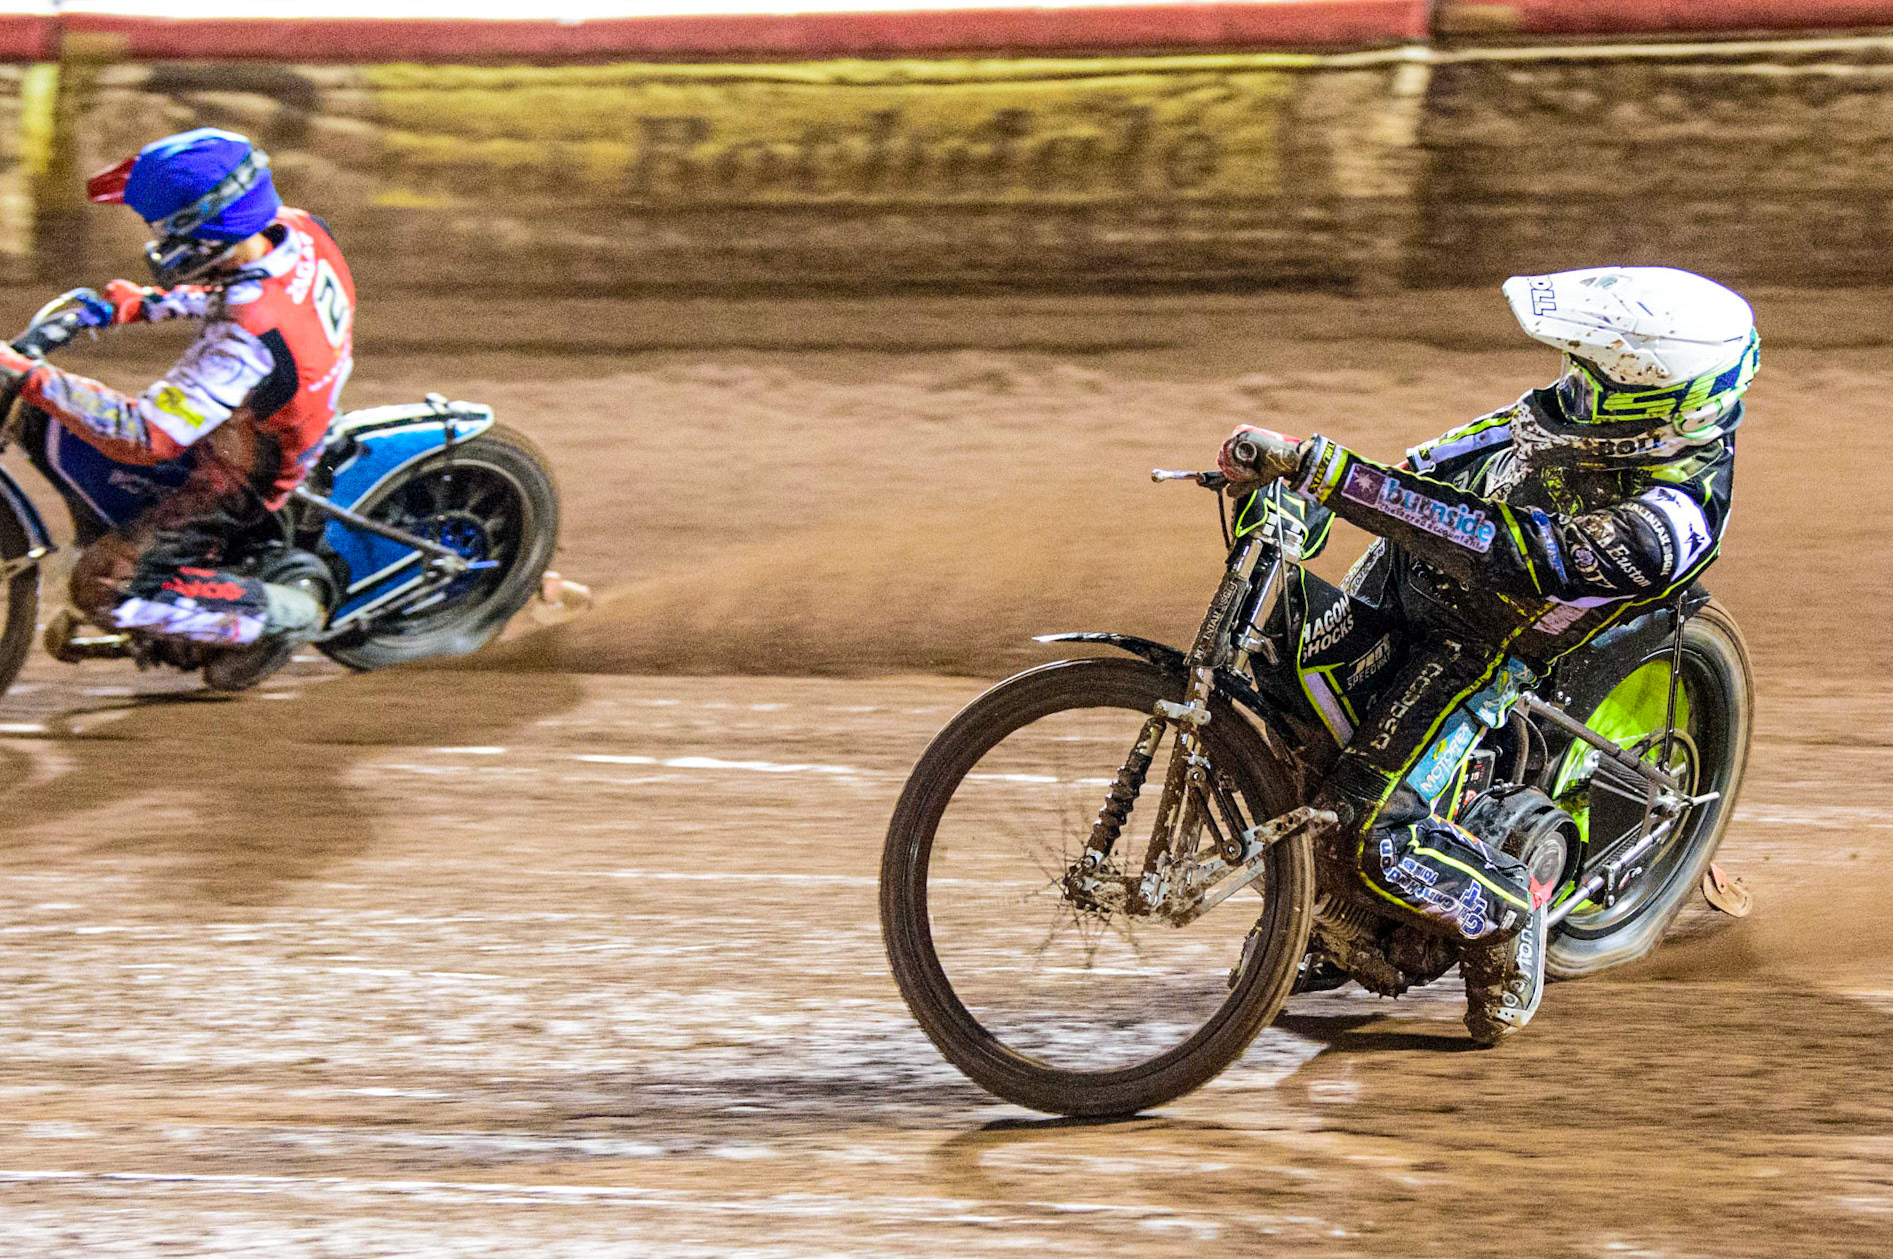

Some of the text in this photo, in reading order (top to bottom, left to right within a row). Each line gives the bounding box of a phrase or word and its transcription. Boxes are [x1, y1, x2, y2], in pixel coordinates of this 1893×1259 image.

[1384, 478, 1493, 544] burnside
[1605, 543, 1652, 588] Euston
[1420, 720, 1474, 794] MOTOREX
